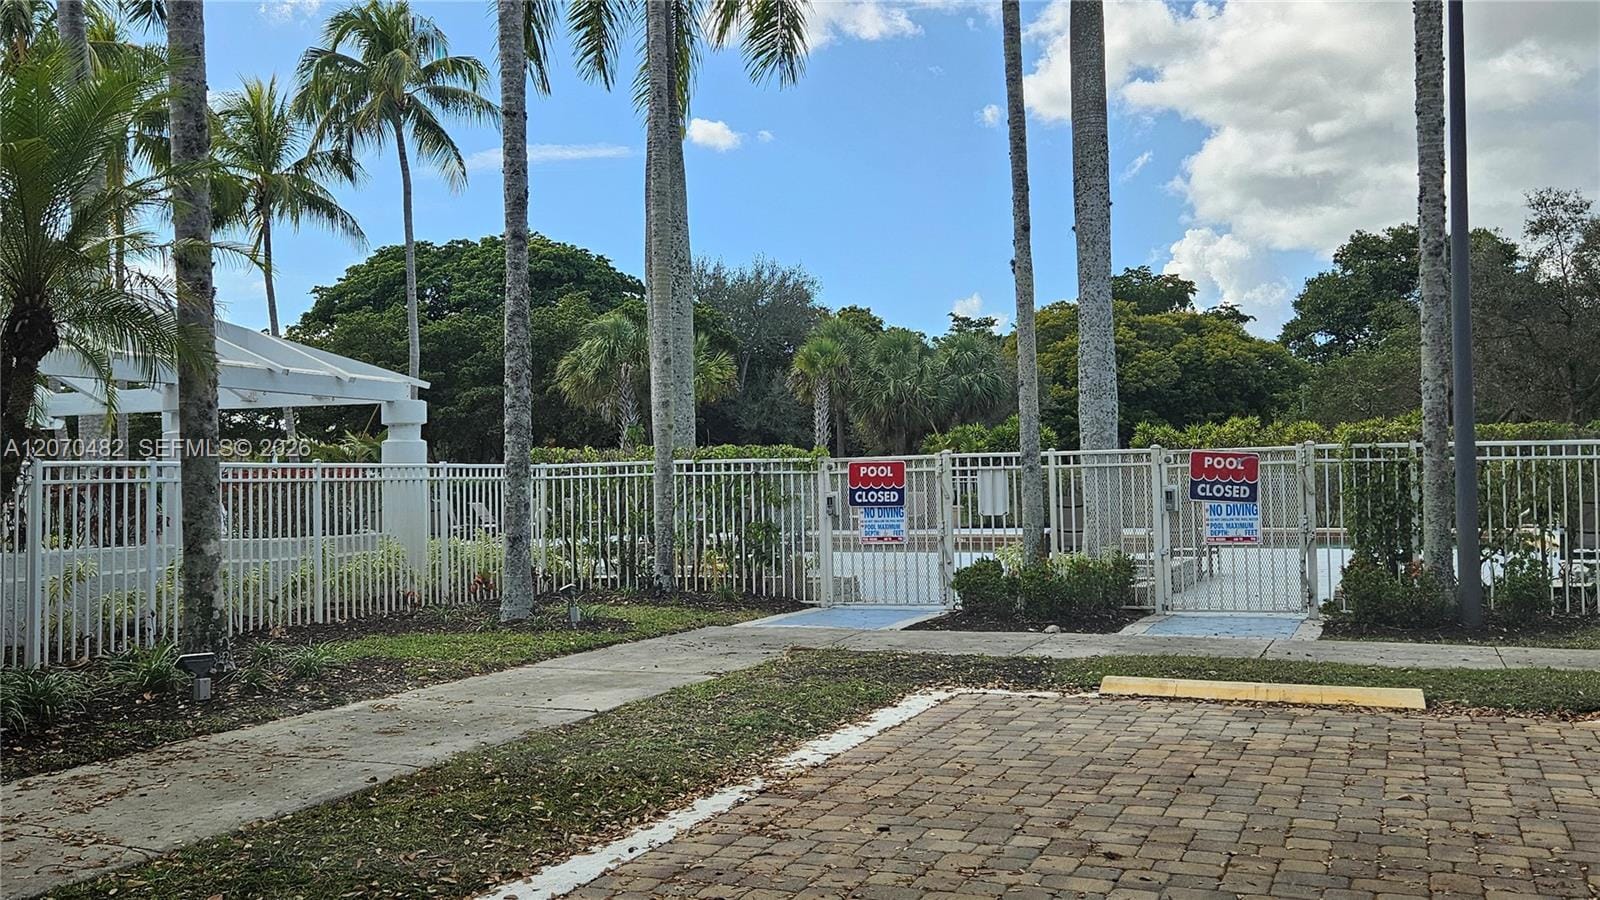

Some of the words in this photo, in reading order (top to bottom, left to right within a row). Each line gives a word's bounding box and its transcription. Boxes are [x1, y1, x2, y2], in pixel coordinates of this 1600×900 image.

[1204, 456, 1245, 470] POOL
[860, 466, 893, 477] POOL
[1197, 483, 1250, 498] CLOSED
[855, 491, 899, 503] CLOSED
[864, 507, 875, 518] NO
[877, 507, 904, 518] DIVING
[1209, 504, 1223, 516] NO
[1226, 504, 1258, 516] DIVING
